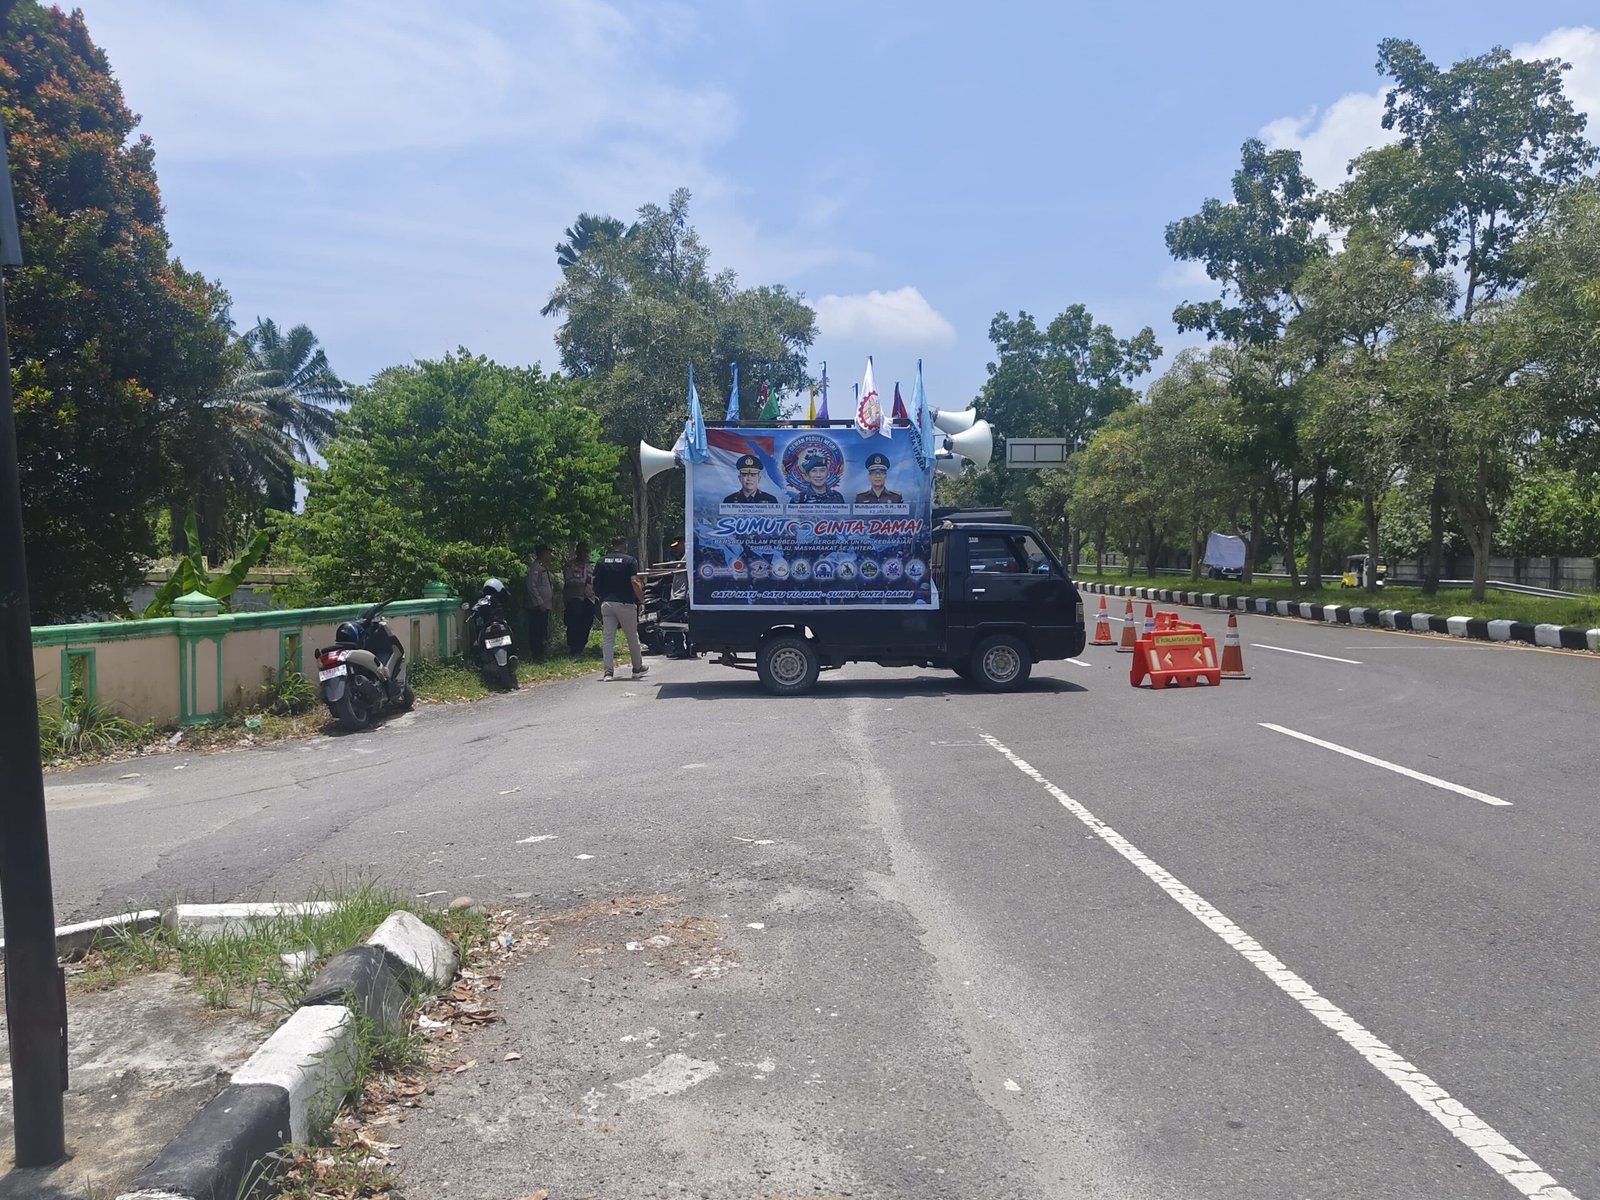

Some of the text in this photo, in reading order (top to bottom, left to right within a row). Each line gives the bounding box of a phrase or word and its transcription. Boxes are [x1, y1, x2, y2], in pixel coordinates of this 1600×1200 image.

[708, 517, 923, 536] SUMUT CINTA DAMAI
[711, 590, 735, 599] SATU
[762, 590, 786, 599] SATU
[786, 590, 822, 599] TUJUAN
[826, 590, 859, 599] SUMUT
[858, 590, 884, 599] CINTA
[884, 590, 914, 599] DAMAI
